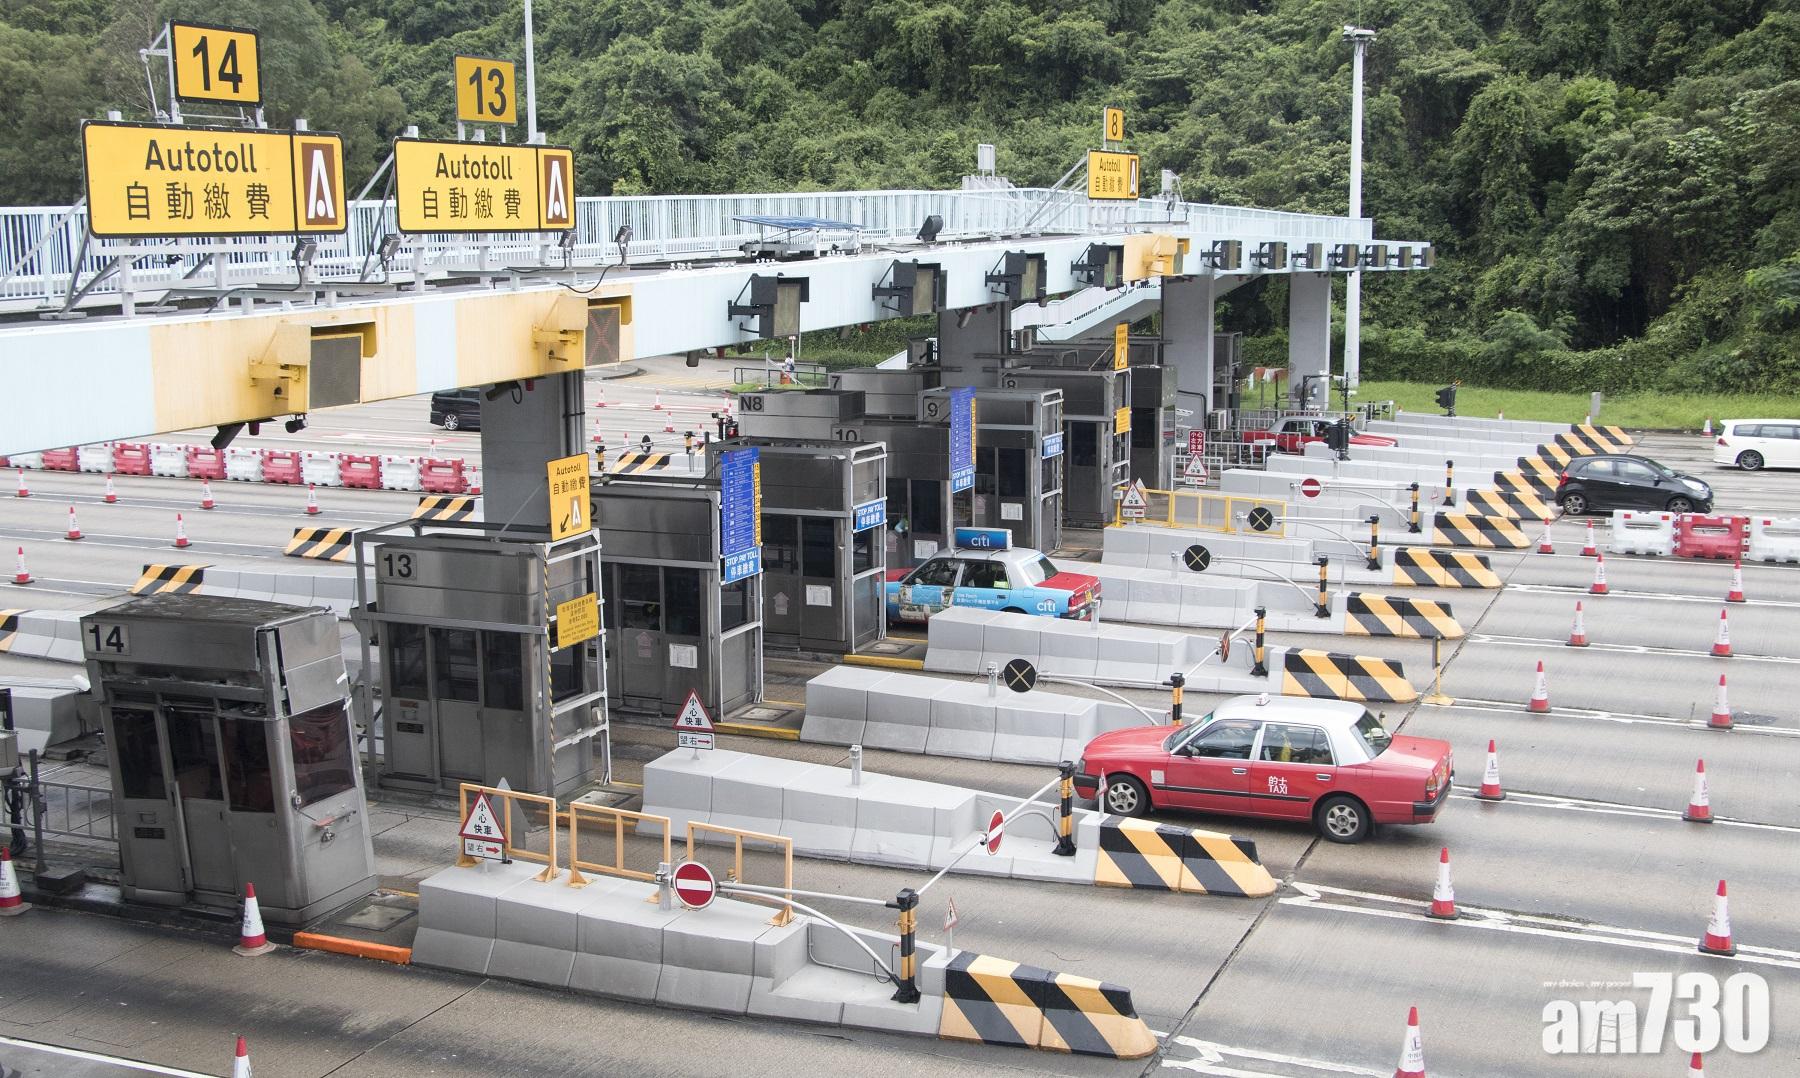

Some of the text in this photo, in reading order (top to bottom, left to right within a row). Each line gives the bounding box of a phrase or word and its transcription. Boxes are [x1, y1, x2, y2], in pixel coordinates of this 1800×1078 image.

[193, 35, 243, 93] 14
[469, 67, 507, 116] 13
[1111, 113, 1119, 137] 8
[146, 139, 257, 174] Autotoll
[435, 152, 513, 180] Autotoll
[1099, 158, 1121, 172] Autotoll
[126, 181, 270, 221] 自動繳費
[421, 187, 521, 219] 自動繳費
[831, 376, 841, 389] 7
[741, 396, 763, 411] N8
[927, 402, 938, 416] 9
[835, 428, 858, 441] 10
[556, 463, 582, 476] Autotoll
[857, 508, 867, 516] STOP
[874, 503, 883, 511] TOLL
[971, 535, 990, 547] citi
[383, 554, 412, 578] 13
[726, 556, 738, 567] STOP
[746, 550, 758, 562] TOLL
[1036, 600, 1056, 612] citi
[89, 624, 124, 653] 14
[1268, 775, 1288, 786] 的士
[1268, 784, 1288, 795] TAXI
